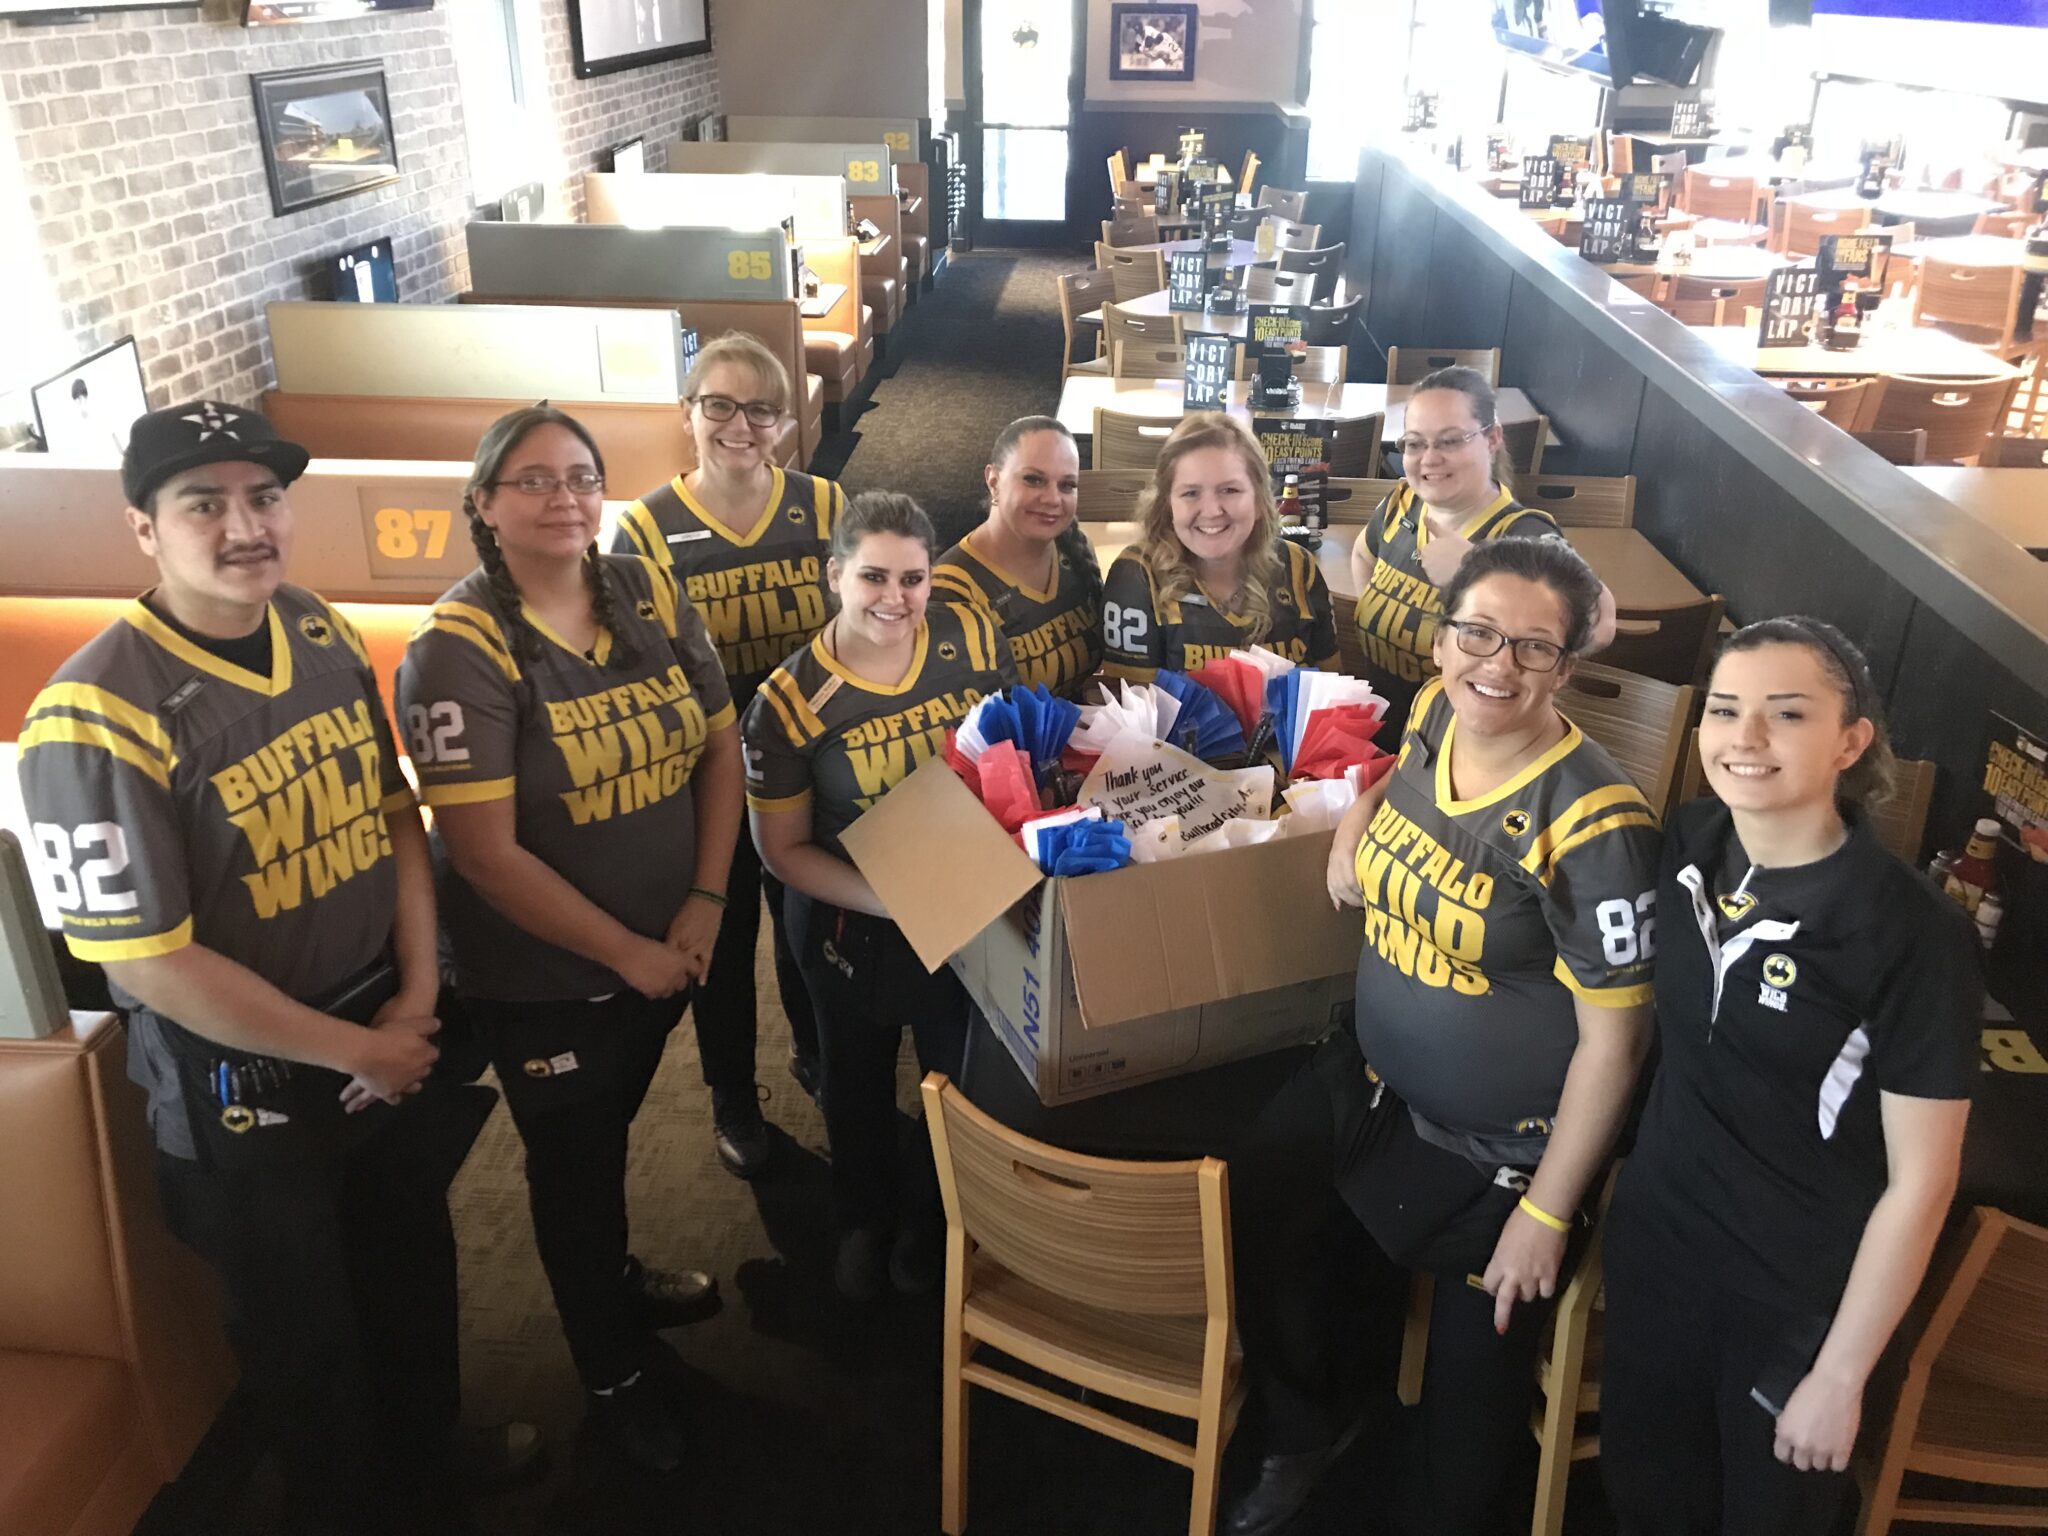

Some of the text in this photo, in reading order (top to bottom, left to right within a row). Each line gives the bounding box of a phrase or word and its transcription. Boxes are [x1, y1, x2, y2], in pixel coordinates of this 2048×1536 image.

[883, 132, 911, 151] 82
[848, 160, 879, 182] 83
[1525, 160, 1554, 173] VICT
[1530, 175, 1553, 187] ORY
[1522, 190, 1543, 203] LAP
[1588, 203, 1624, 220] VICT
[1593, 222, 1621, 238] ORY
[1583, 238, 1609, 255] LAP
[727, 250, 773, 281] 85
[1173, 256, 1202, 273] VICT
[1178, 274, 1201, 289] ORY
[1775, 273, 1818, 294] VICT
[1171, 291, 1193, 304] LAP
[1780, 296, 1813, 316] ORY
[1767, 319, 1798, 339] LAP
[1188, 342, 1226, 364] VICT
[1196, 364, 1225, 384] ORY
[1187, 383, 1214, 403] LAP
[1274, 446, 1293, 457] EASY
[1294, 447, 1323, 458] POINTS
[374, 507, 452, 559] 87
[686, 556, 820, 601] BUFFALO
[1370, 557, 1446, 616] BUFFAL
[690, 584, 827, 644] WILD
[1103, 600, 1149, 654] 82
[1007, 606, 1098, 663] BUFFAL
[545, 665, 691, 734] BUFFALO
[407, 701, 470, 763] 82
[842, 687, 985, 749] BUFFALO
[208, 699, 375, 813] BUFFALO
[552, 697, 707, 787] WILD
[558, 744, 706, 826] WINGS
[1105, 762, 1164, 792] Thank you
[1983, 762, 2003, 796] 10
[227, 740, 382, 868] WILD
[1111, 790, 1141, 811] your
[1135, 803, 1158, 821] you
[1158, 787, 1192, 808] enjoy
[1187, 778, 1206, 793] our
[33, 820, 139, 912] 82
[1367, 798, 1495, 910] BUFFALO
[1354, 830, 1487, 970] WILD
[1363, 896, 1491, 997] WINGS
[1760, 982, 1788, 1001] WILD
